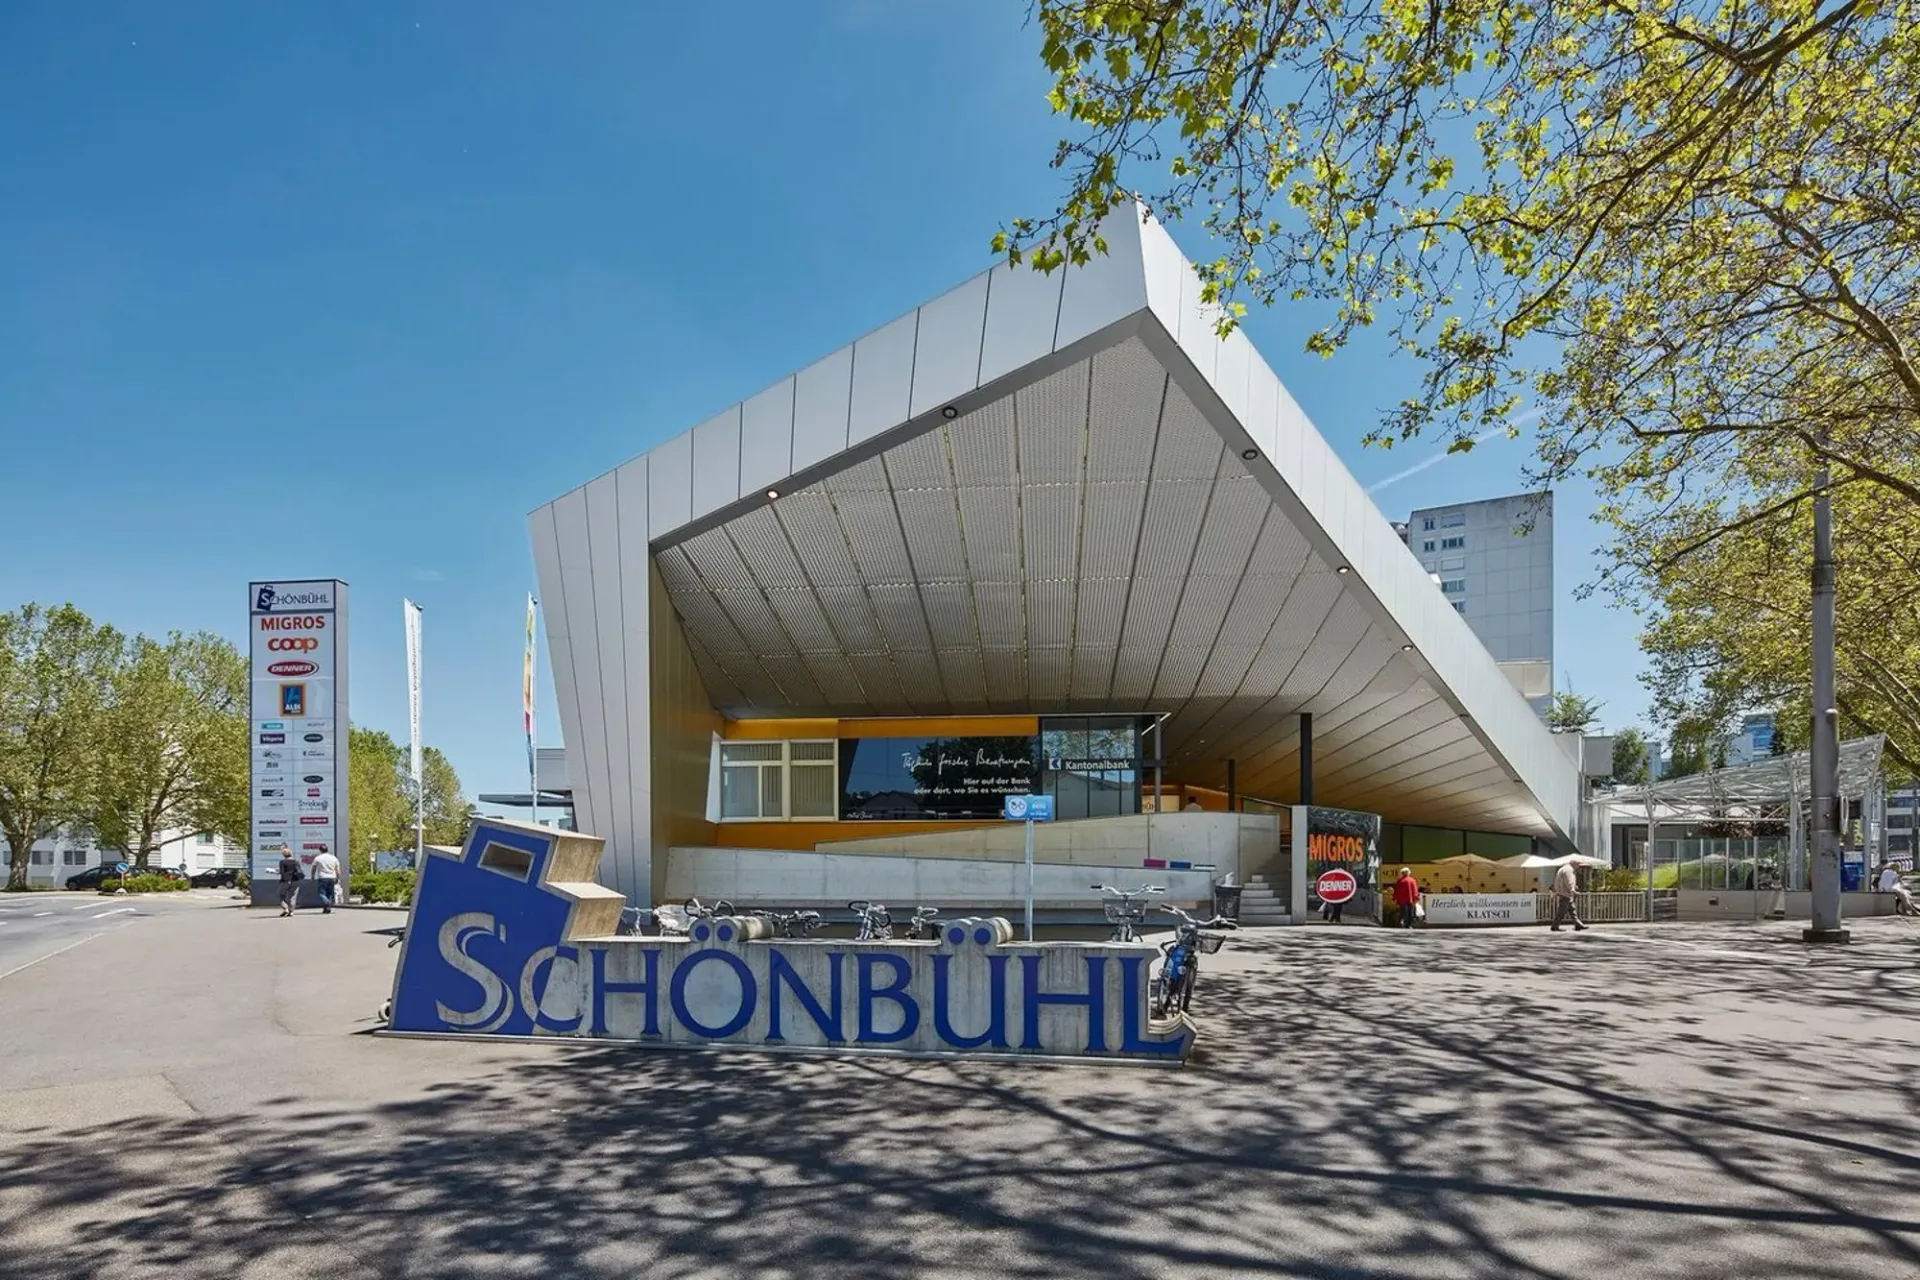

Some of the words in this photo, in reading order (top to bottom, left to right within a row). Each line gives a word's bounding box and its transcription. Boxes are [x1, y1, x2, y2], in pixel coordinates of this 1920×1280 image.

[260, 592, 329, 607] SCHÖNBÜHL
[260, 615, 325, 631] MIGROS
[267, 638, 318, 653] coop
[270, 664, 312, 673] DENNER
[1065, 760, 1130, 770] Kantonalbank
[1010, 777, 1031, 785] Bank
[1308, 833, 1364, 863] MIGROS
[1319, 880, 1352, 891] DENNER
[1431, 898, 1466, 909] Herzlich
[1468, 898, 1519, 908] willkommen
[1520, 899, 1532, 908] im
[1466, 910, 1510, 919] KLATSCH
[435, 912, 1184, 1055] SCHÖNBÜHL
